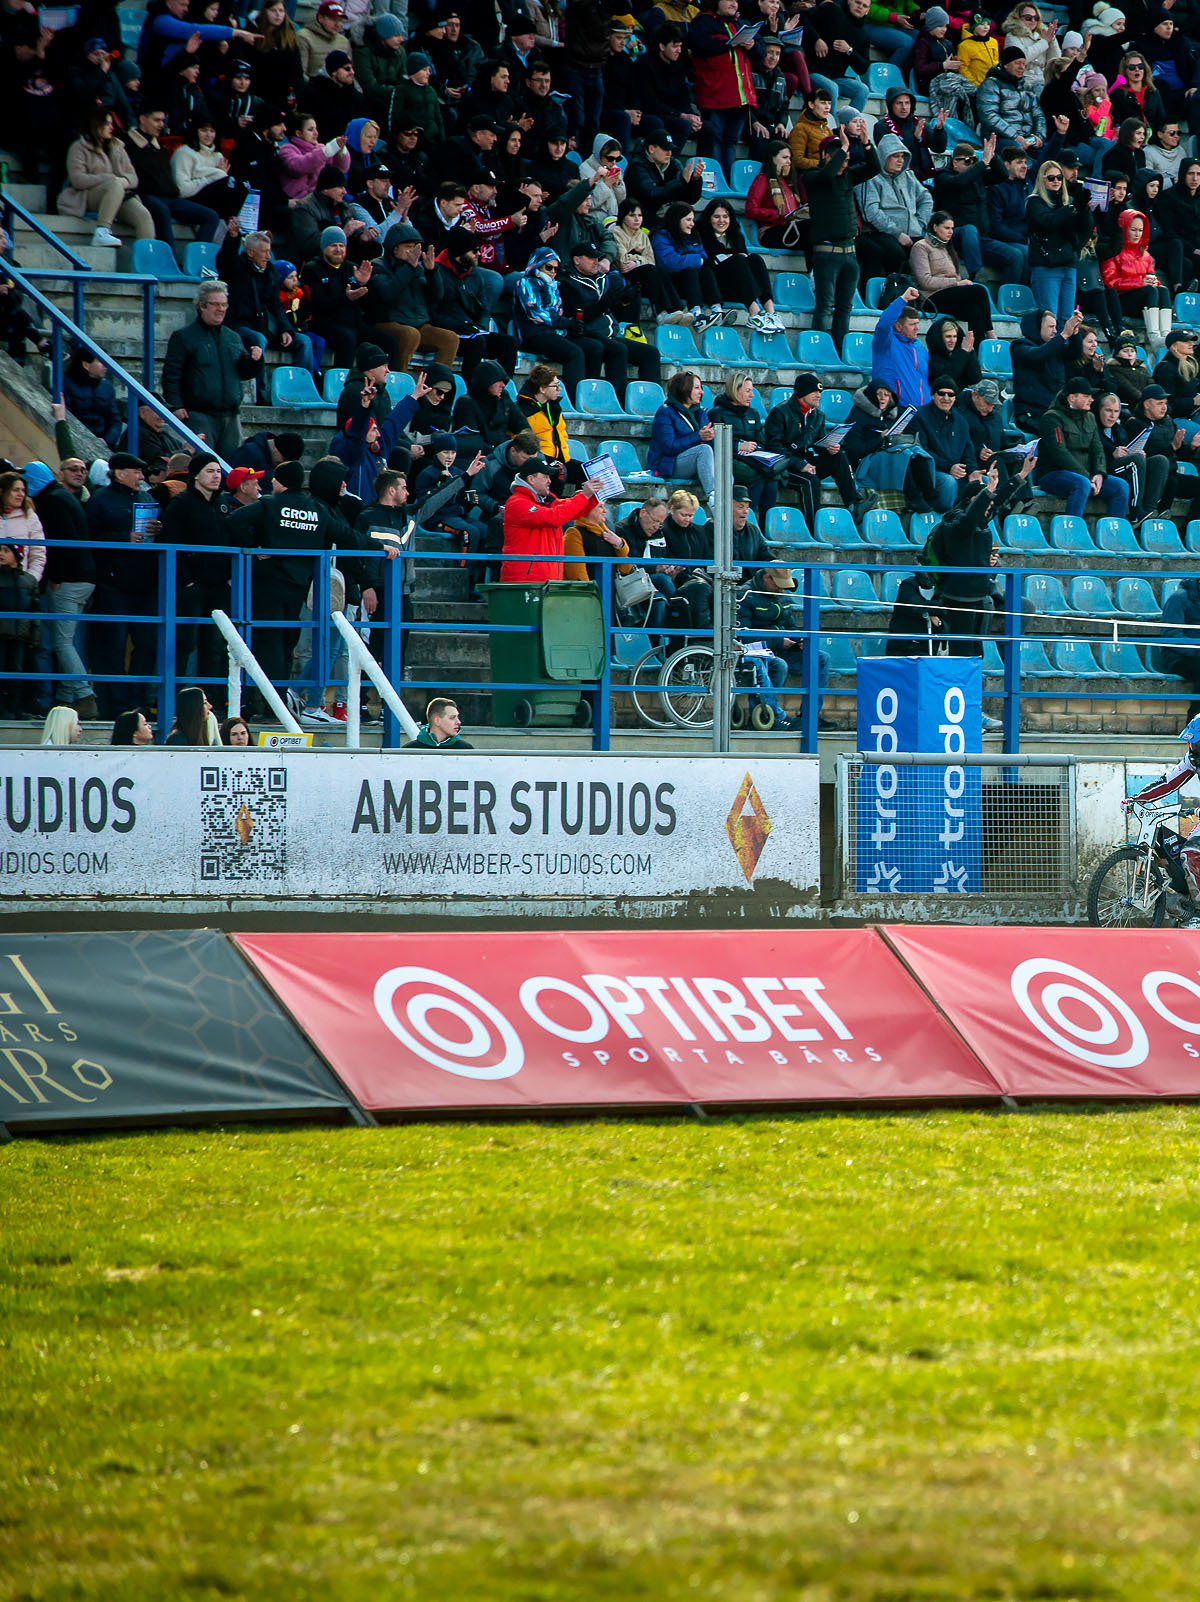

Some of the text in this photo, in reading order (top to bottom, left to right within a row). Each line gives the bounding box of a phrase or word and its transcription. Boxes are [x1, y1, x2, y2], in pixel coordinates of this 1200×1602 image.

[992, 344, 1001, 352] 17
[280, 519, 319, 532] SECURITY
[281, 507, 319, 522] GROM
[1018, 519, 1027, 527] 13
[1110, 521, 1118, 530] 15
[870, 687, 898, 850] trodo
[938, 686, 966, 850] trodo
[0, 777, 137, 835] UDIOS
[352, 780, 677, 836] AMBER STUDIOS
[382, 852, 651, 876] WWW.AMBER-STUDIOS.COM
[519, 974, 854, 1043] OPTIBET
[562, 1046, 882, 1067] SPORTA BĀRS
